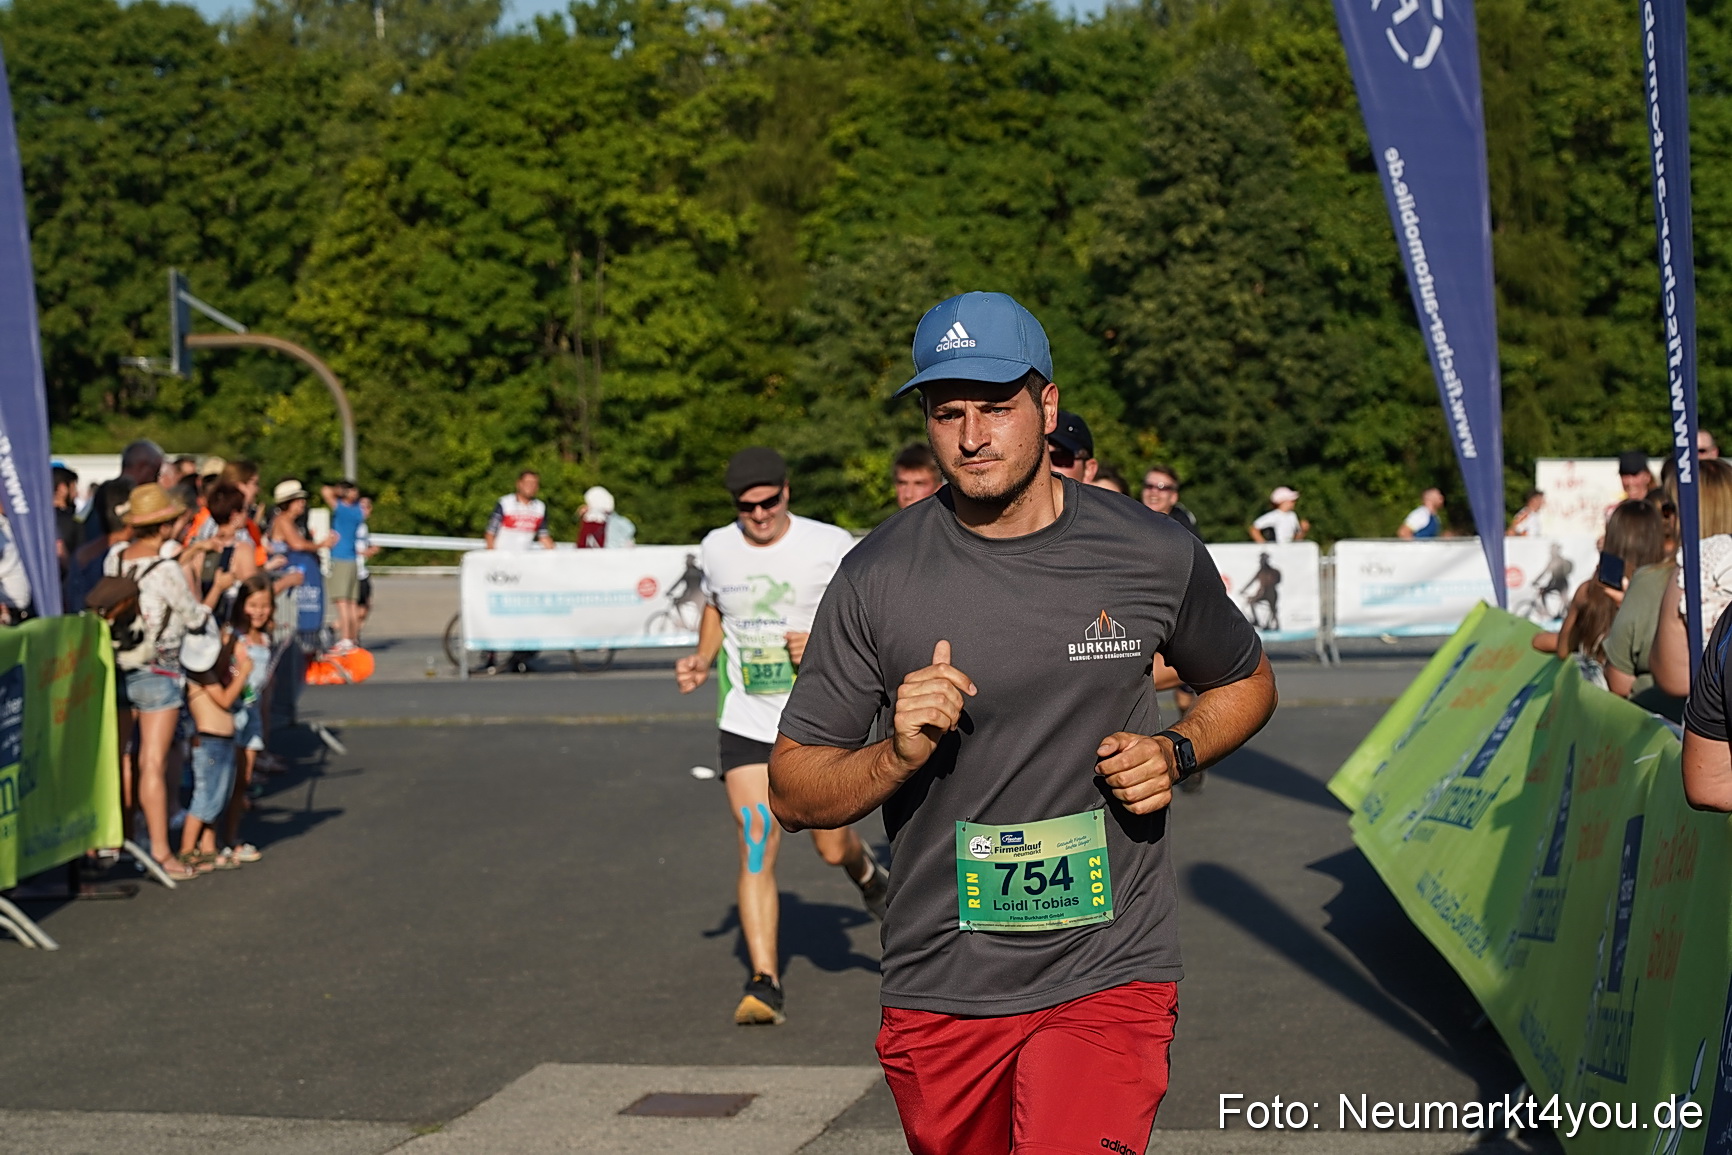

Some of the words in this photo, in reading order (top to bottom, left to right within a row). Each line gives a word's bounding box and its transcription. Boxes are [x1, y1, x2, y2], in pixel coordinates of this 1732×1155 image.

[936, 339, 976, 352] adidas
[1068, 640, 1141, 654] BURKHARDT
[994, 841, 1042, 854] Firmenlauf
[1013, 850, 1042, 858] neumarkt
[994, 856, 1074, 896] 754
[1088, 855, 1105, 907] 2022
[966, 873, 980, 908] RUN
[993, 899, 1028, 911] Loidl
[1032, 896, 1080, 910] Tobias
